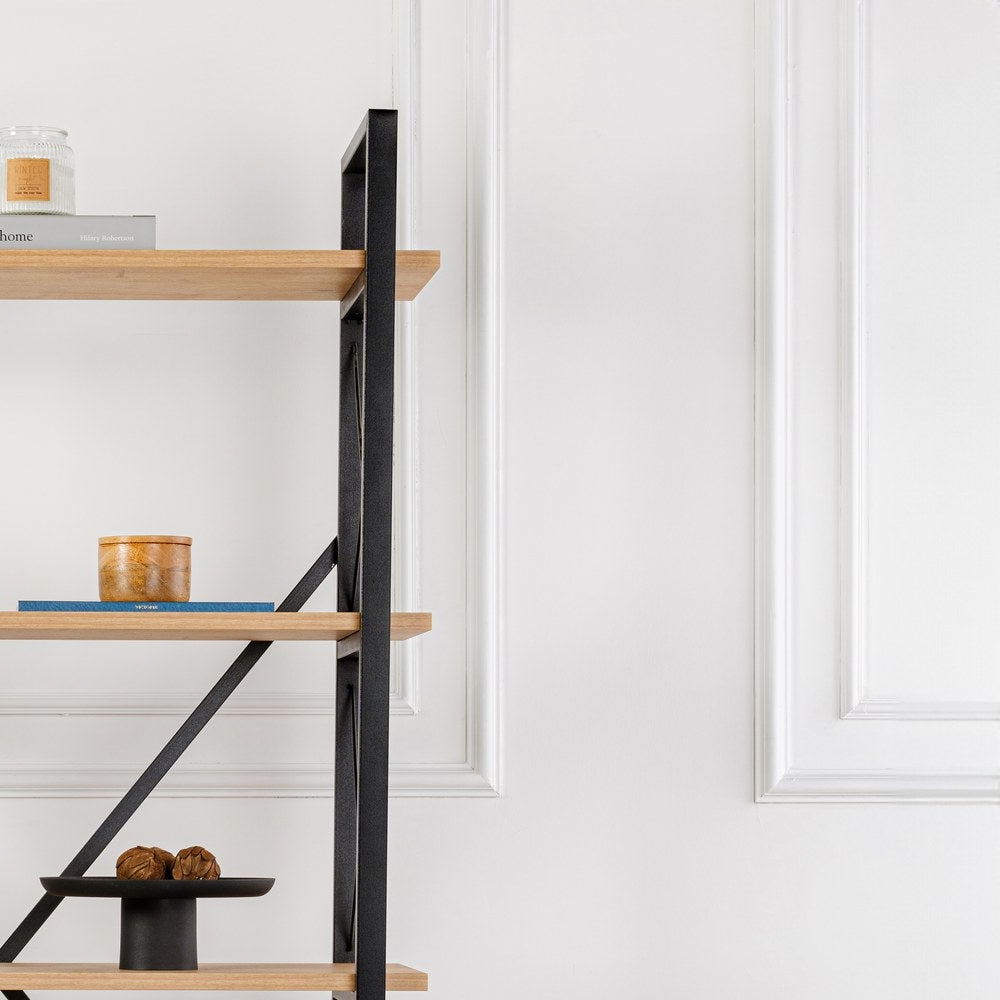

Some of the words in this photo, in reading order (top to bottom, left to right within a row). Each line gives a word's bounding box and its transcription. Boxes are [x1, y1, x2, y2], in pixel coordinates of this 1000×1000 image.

[0, 229, 34, 242] home
[80, 234, 100, 243] Hilary
[101, 234, 134, 242] Robertson
